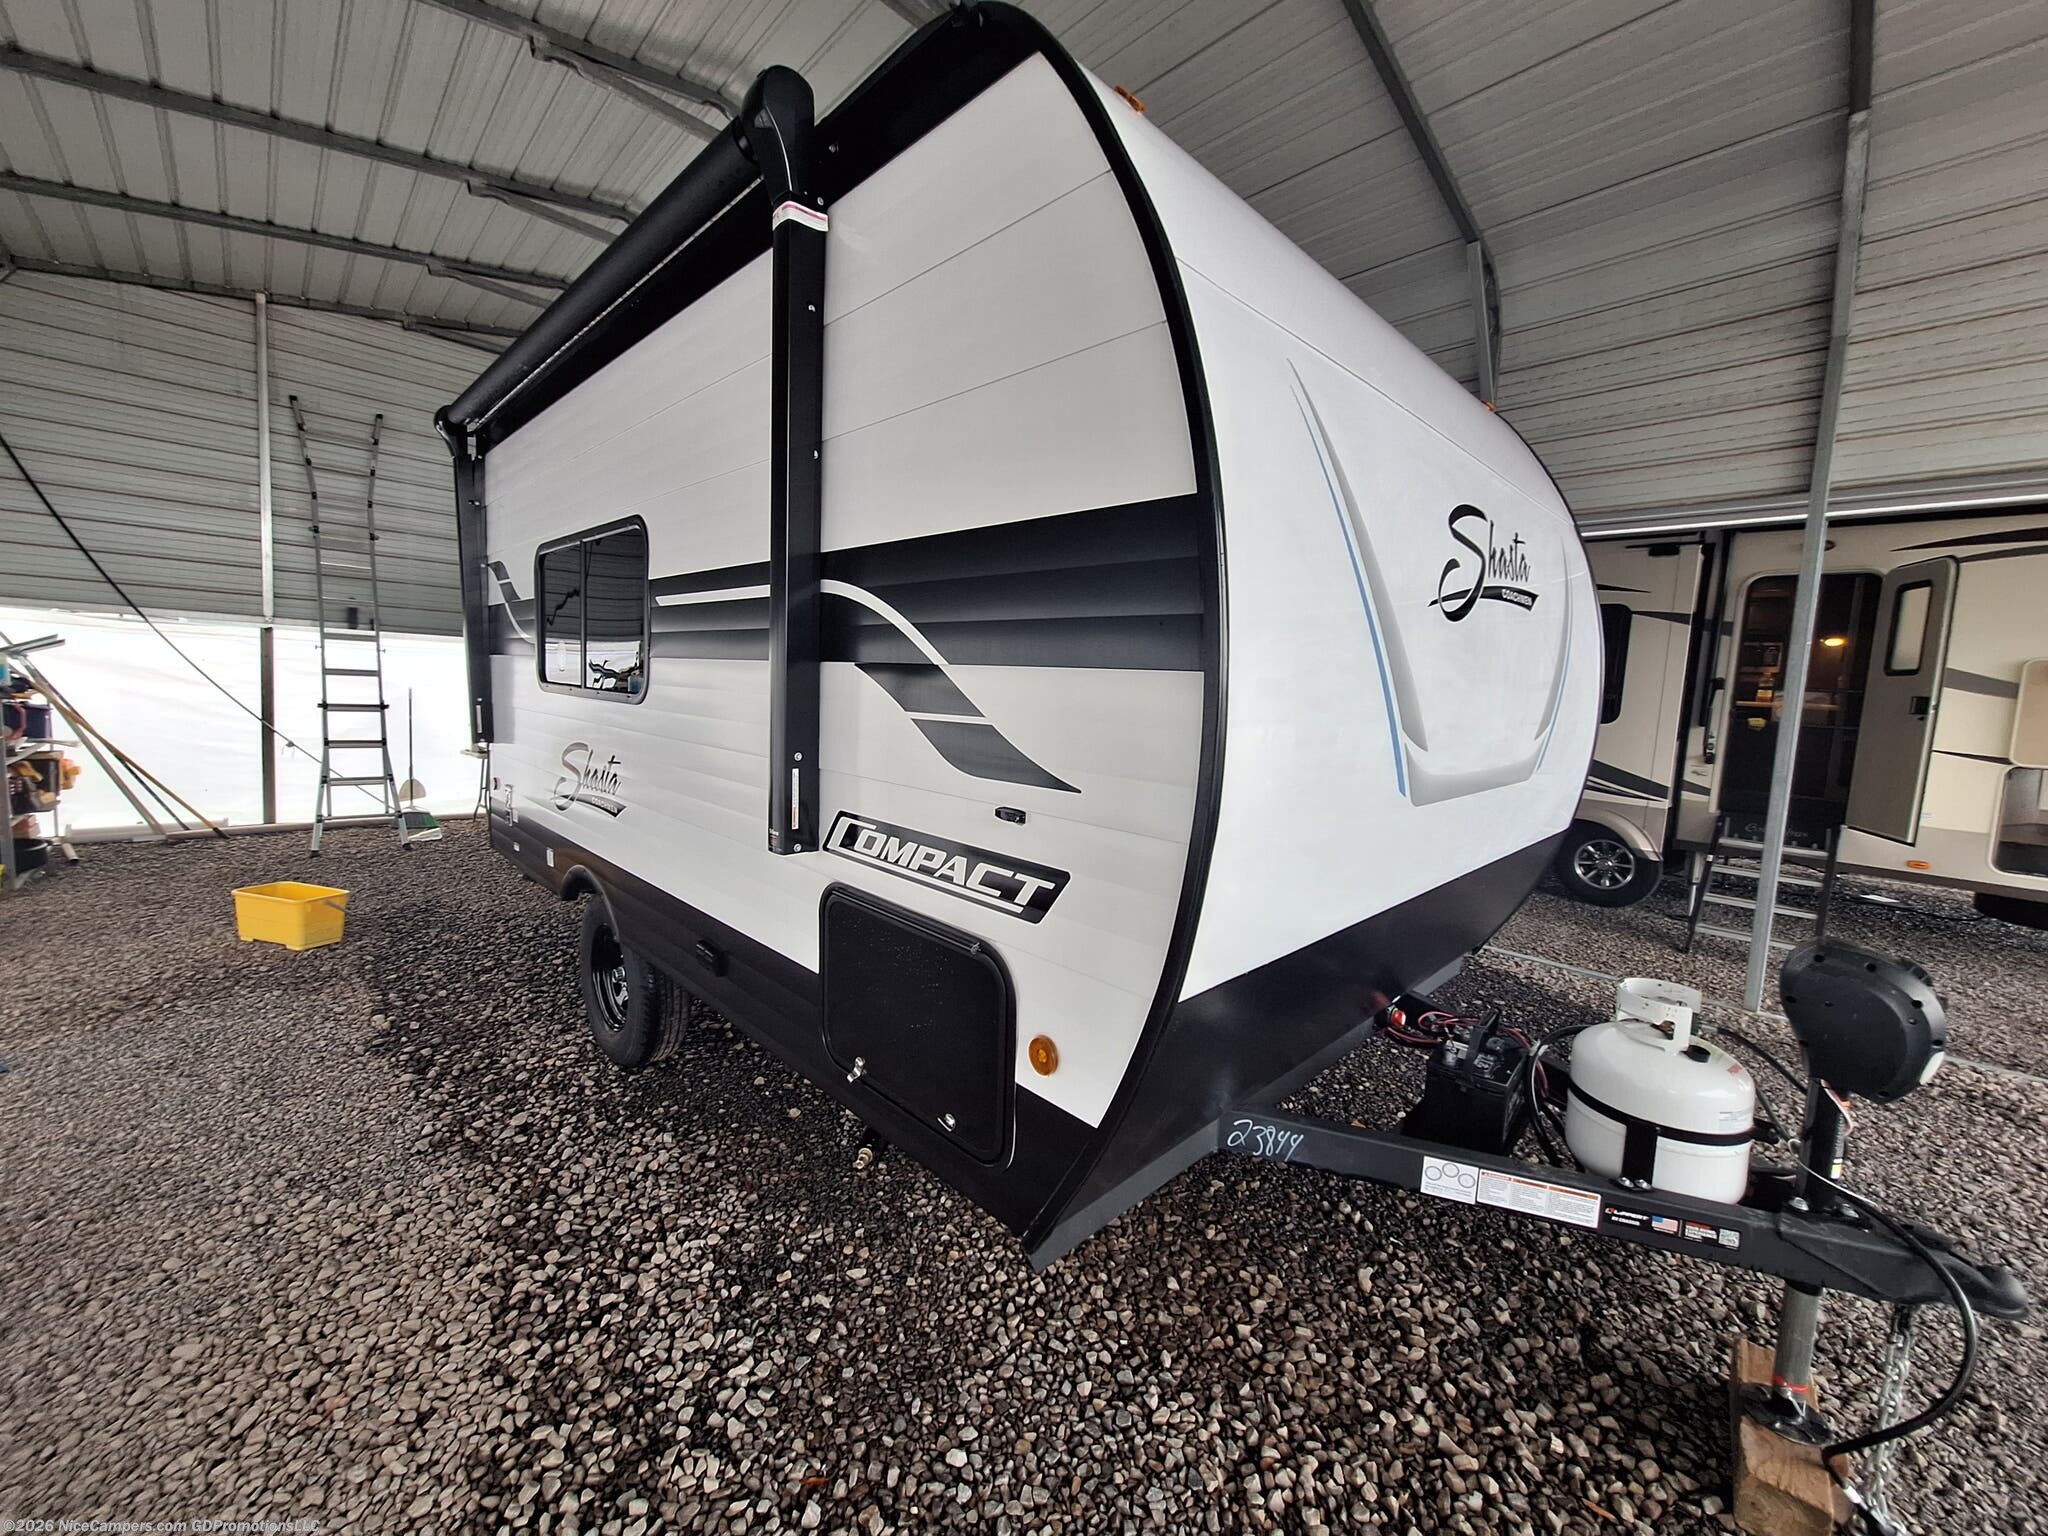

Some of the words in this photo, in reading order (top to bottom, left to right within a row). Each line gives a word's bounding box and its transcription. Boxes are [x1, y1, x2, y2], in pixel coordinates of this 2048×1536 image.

[1437, 503, 1531, 622] Shasta
[553, 742, 622, 811] Shasta
[826, 816, 1056, 907] COMPACT
